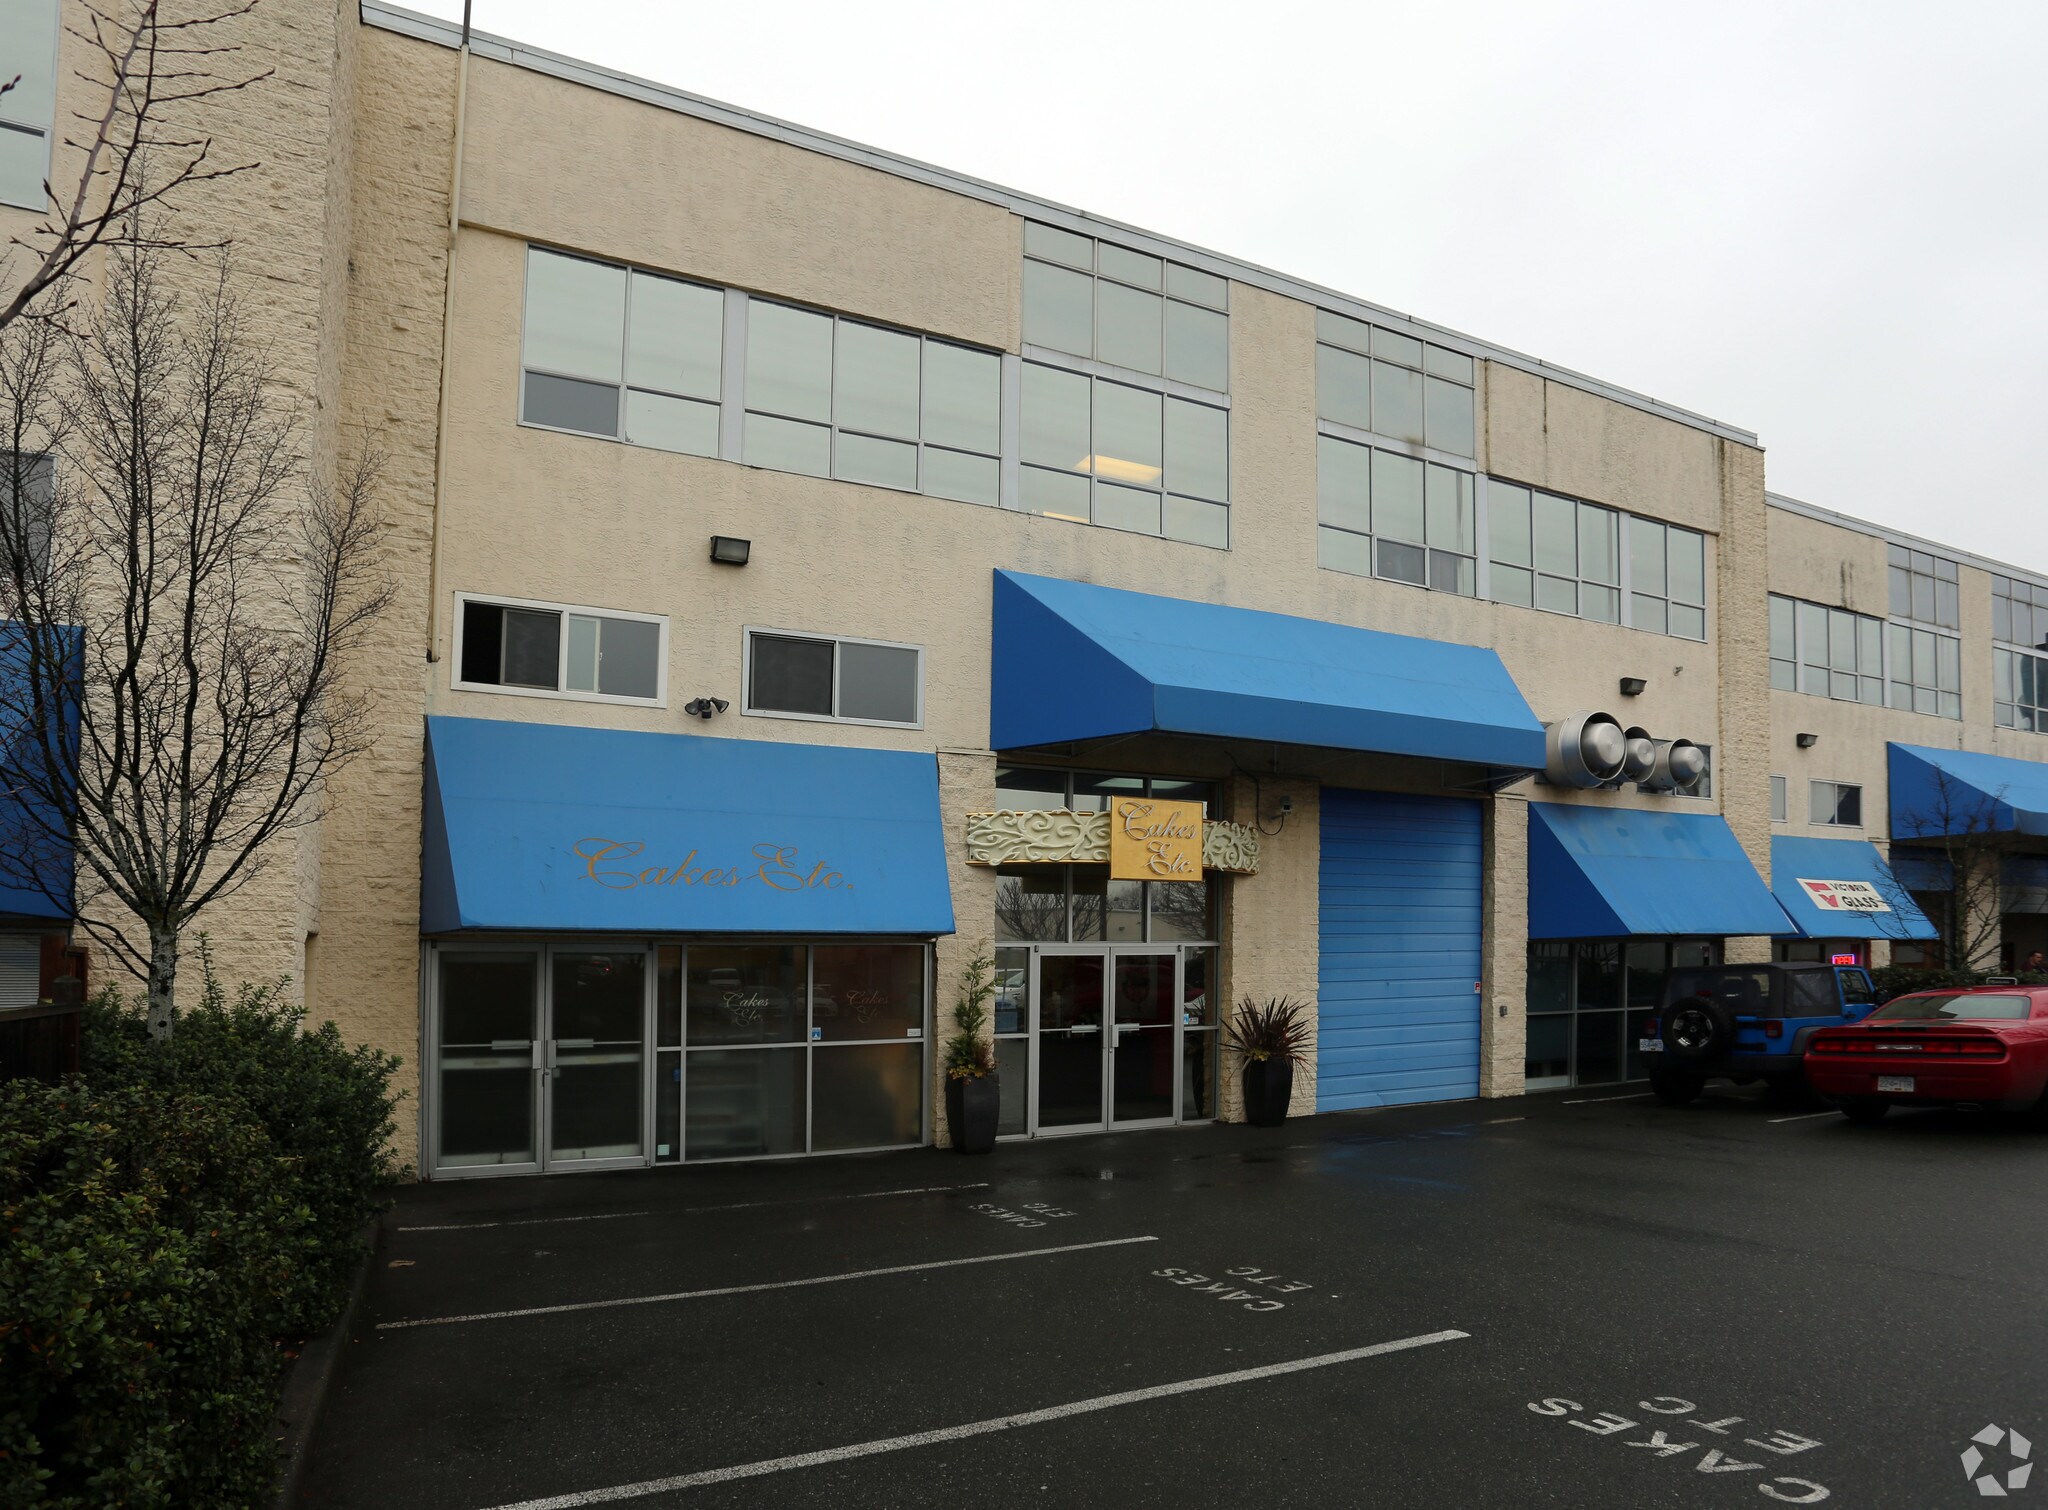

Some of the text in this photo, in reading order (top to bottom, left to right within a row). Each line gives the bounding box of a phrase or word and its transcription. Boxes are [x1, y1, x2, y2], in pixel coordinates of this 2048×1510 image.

[1118, 802, 1197, 840] Cakes
[573, 837, 855, 891] Cakes Etc.
[1143, 840, 1195, 876] Etc.
[1830, 882, 1869, 892] VICTORIA
[1842, 895, 1879, 908] GLASS
[723, 992, 769, 1011] Cakes
[846, 990, 889, 1005] Cakes
[1151, 1268, 1285, 1311] CAKES
[1225, 1267, 1313, 1292] ETC
[1638, 1396, 1825, 1455] ETC
[1527, 1397, 1831, 1504] CAKES
